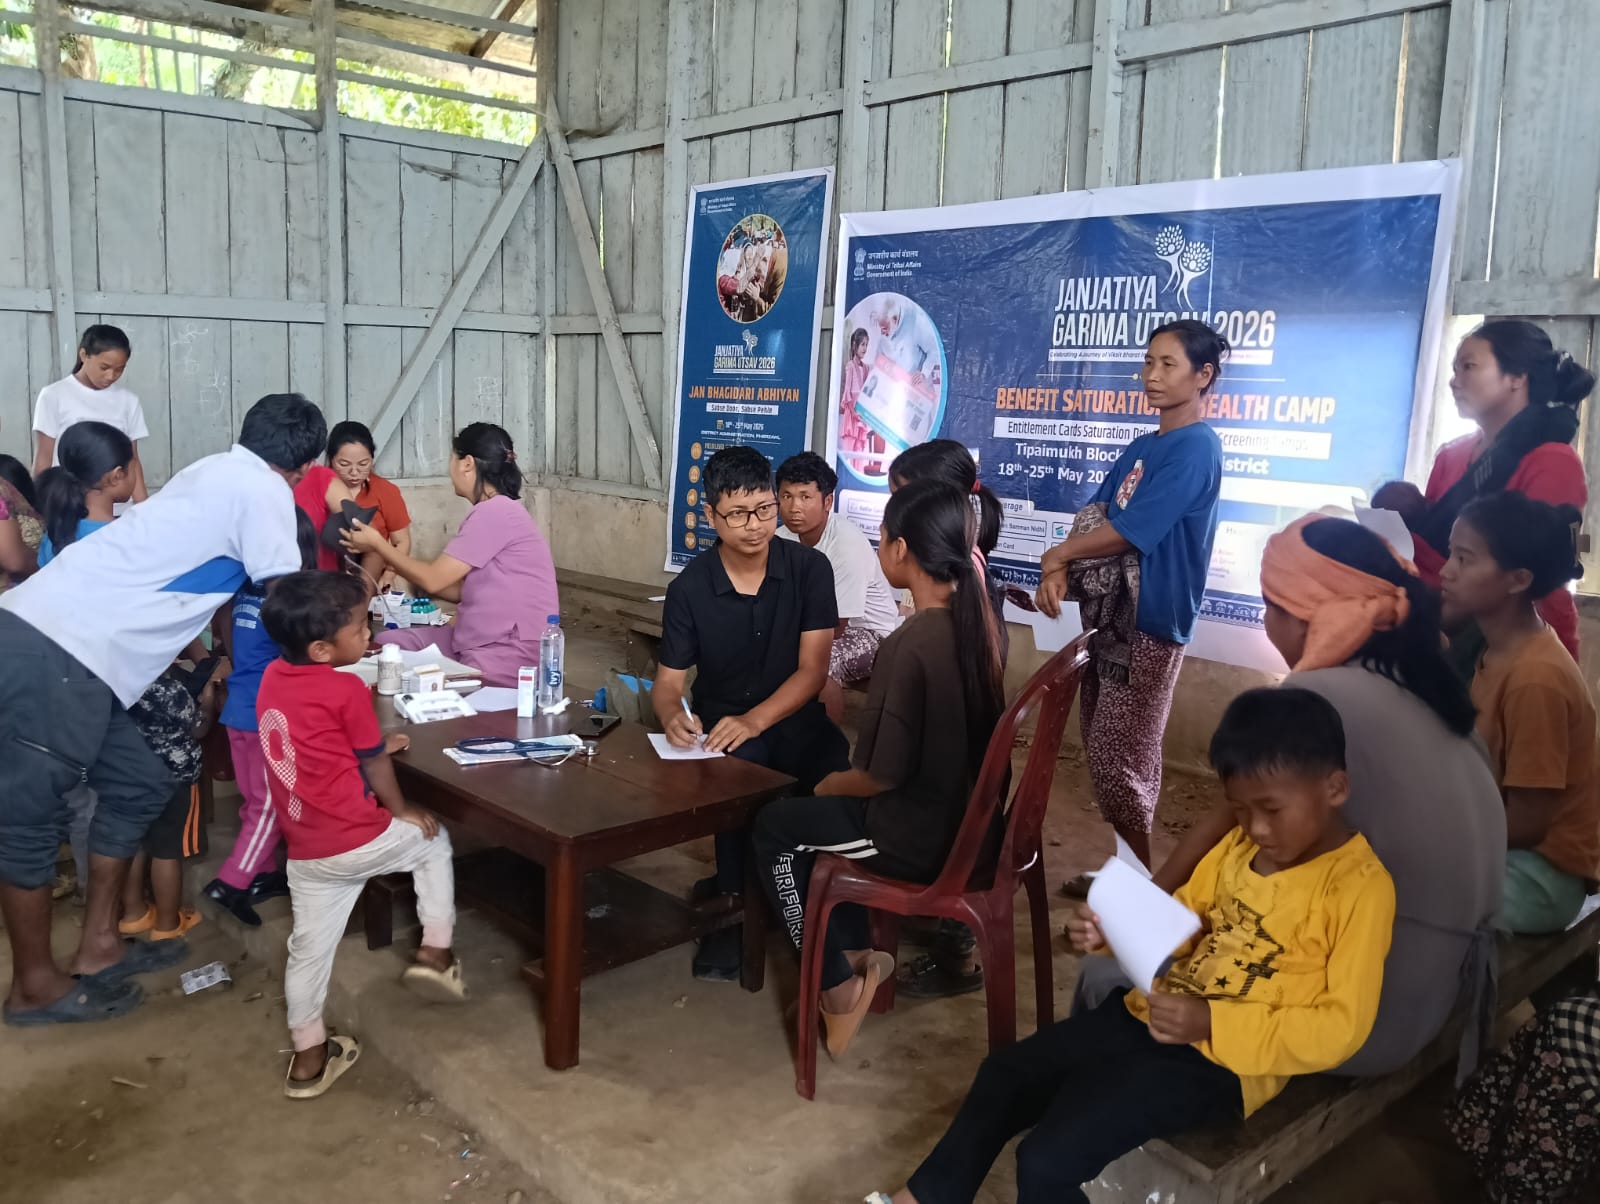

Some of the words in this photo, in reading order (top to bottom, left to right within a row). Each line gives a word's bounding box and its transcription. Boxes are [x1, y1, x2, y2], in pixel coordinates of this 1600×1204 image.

[866, 270, 894, 278] Government
[1054, 275, 1157, 312] JANJATIYA
[1052, 312, 1129, 347] GARIMA
[1214, 310, 1276, 348] 2026
[714, 345, 744, 357] JANJATIYA
[713, 357, 737, 369] GARIMA
[758, 357, 776, 369] 2026
[688, 385, 705, 399] JAN
[707, 386, 754, 400] BHAGIDARI
[756, 388, 800, 402] ABHIYAN
[995, 387, 1060, 412] BENEFIT
[1062, 388, 1161, 416] SATURATIO
[1274, 395, 1336, 425] CAMP
[1008, 421, 1057, 436] Entitlement
[1058, 423, 1082, 437] Cards
[1083, 424, 1130, 440] Saturation
[1016, 442, 1082, 460] Tipaimukh
[998, 462, 1022, 476] 18th
[1057, 467, 1083, 485] May
